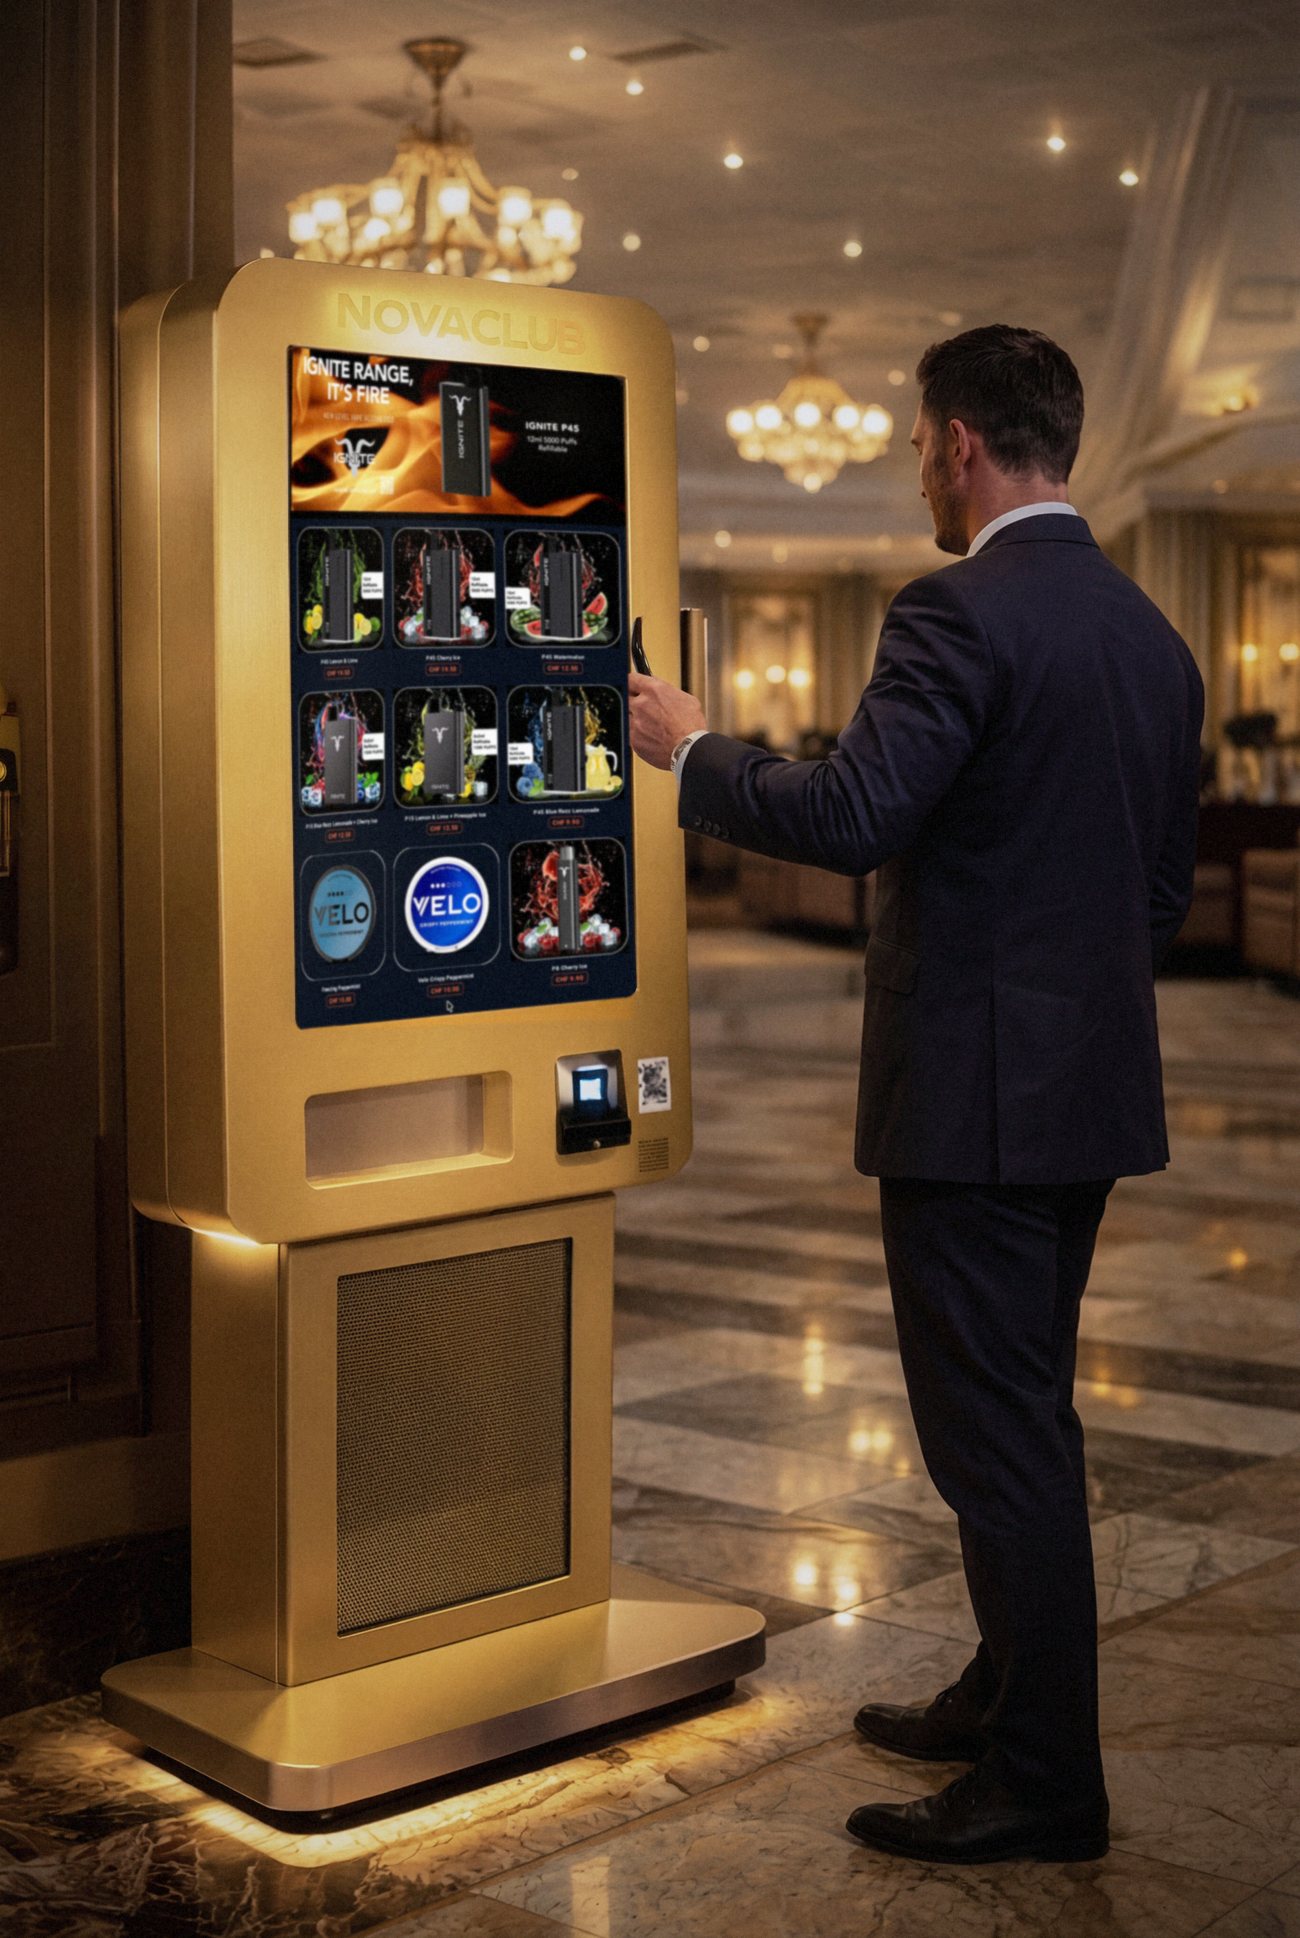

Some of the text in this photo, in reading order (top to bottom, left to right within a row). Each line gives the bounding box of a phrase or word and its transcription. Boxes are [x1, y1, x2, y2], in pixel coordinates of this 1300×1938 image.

[336, 292, 586, 357] NOVACLUB
[303, 355, 413, 386] IGNITE RANGE,
[327, 382, 390, 405] IT'S FIRE
[525, 421, 580, 433] IGNITE P45
[560, 437, 578, 445] Puffs
[333, 452, 375, 465] IGNITE
[313, 901, 369, 926] VELO
[413, 892, 481, 917] VELO
